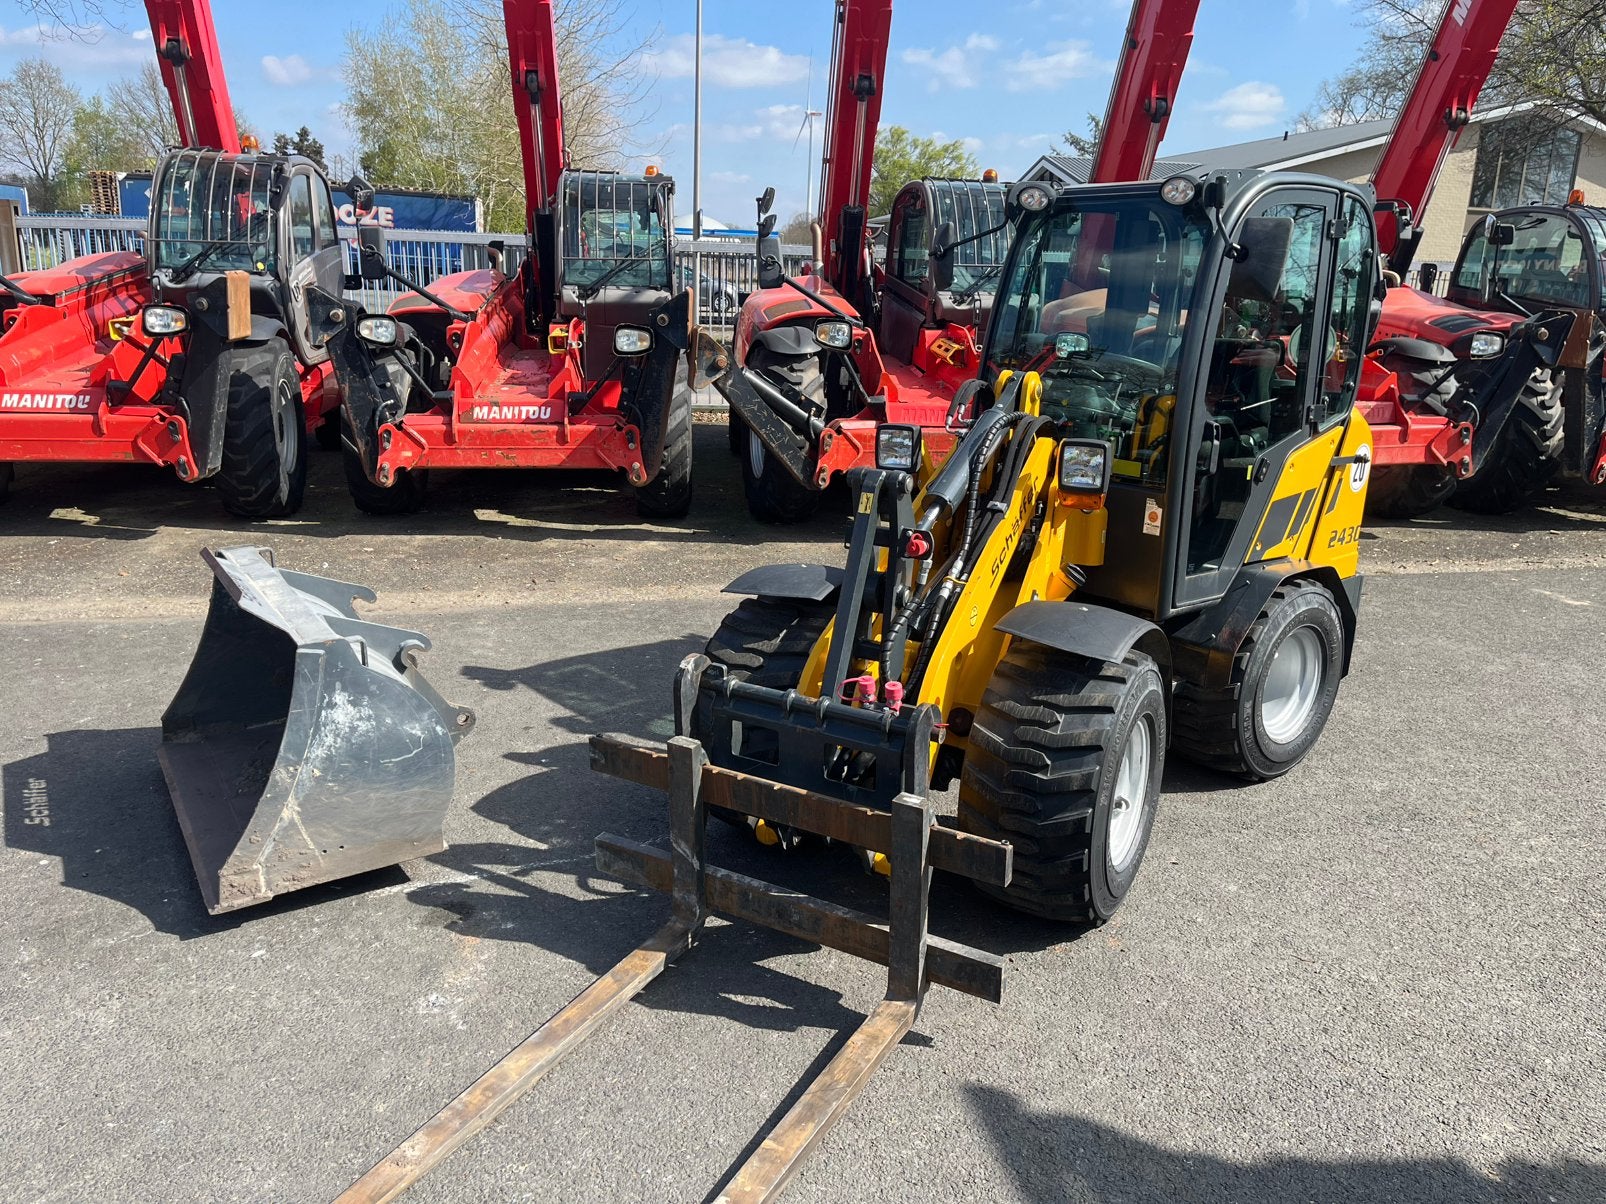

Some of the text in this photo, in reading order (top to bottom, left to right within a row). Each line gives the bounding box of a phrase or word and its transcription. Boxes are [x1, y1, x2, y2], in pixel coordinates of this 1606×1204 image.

[1, 393, 91, 409] MANITOU
[473, 405, 552, 420] MANITOU
[990, 476, 1039, 589] Schäffer
[1327, 525, 1360, 549] 2430
[22, 777, 51, 827] Schäffer
